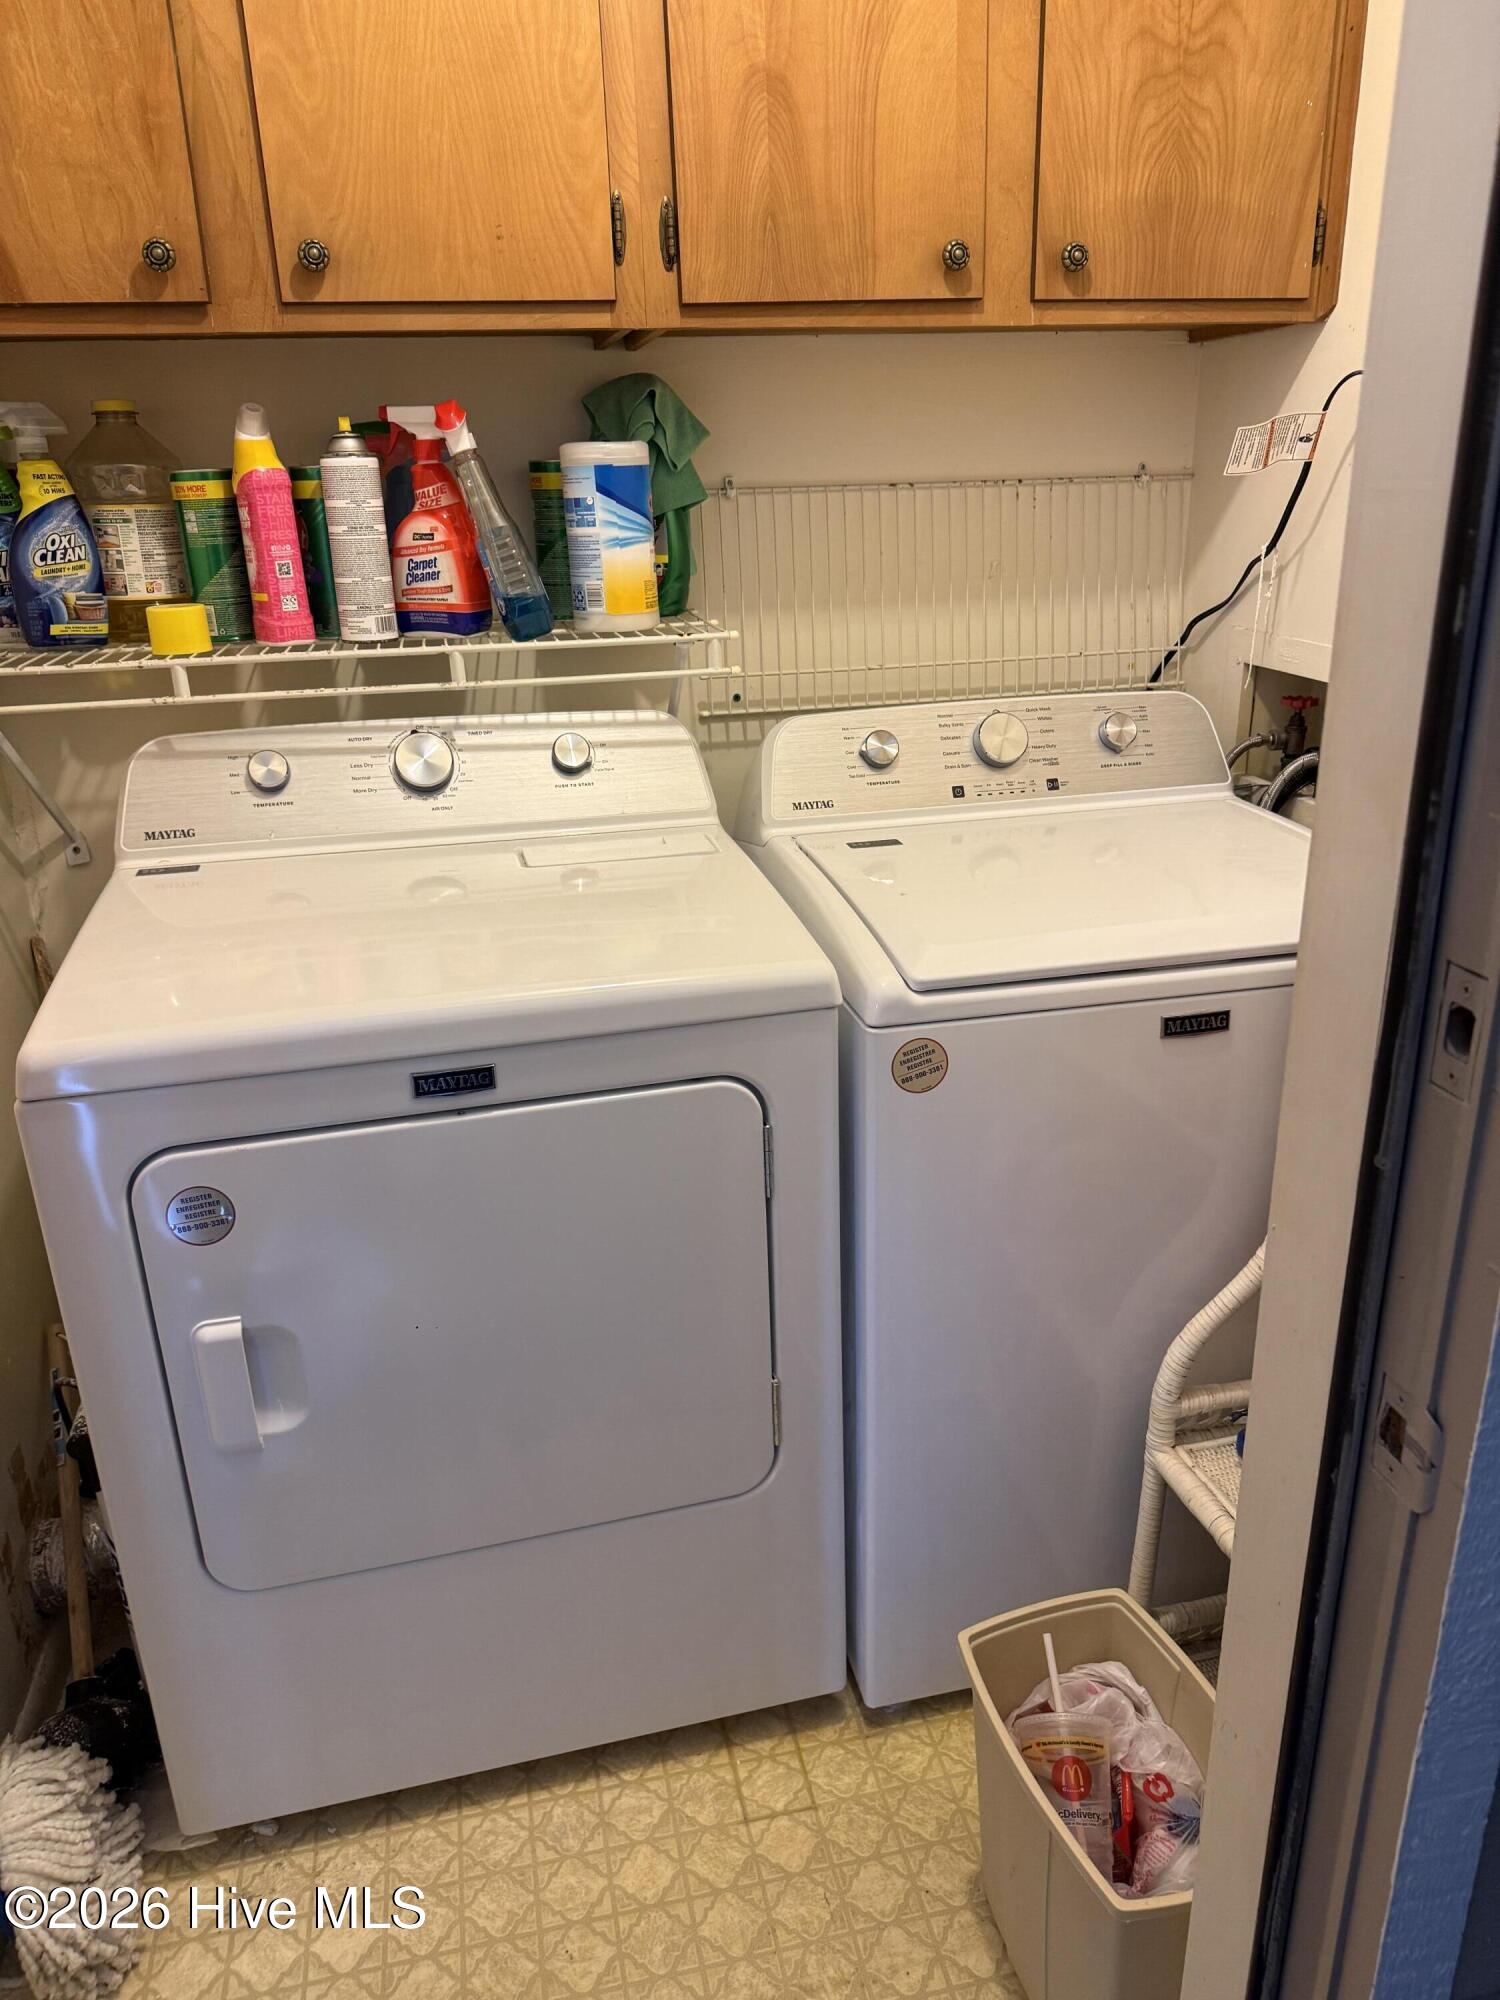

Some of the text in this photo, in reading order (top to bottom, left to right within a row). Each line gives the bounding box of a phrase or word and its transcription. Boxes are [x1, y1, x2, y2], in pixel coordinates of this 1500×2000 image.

[187, 484, 207, 493] MORE
[416, 484, 448, 501] VALUE
[419, 496, 442, 509] SIZE
[45, 532, 76, 551] OXI
[33, 544, 87, 567] CLEAN
[41, 567, 66, 575] LAUNDRY
[408, 557, 437, 571] Carpet
[406, 570, 440, 586] Cleaner
[792, 800, 834, 811] MAYTAG
[143, 828, 196, 841] MAYTAG
[1167, 1014, 1227, 1034] MAYTAG
[899, 1048, 936, 1066] ENREGISTRER
[902, 1044, 929, 1058] REGISTER
[906, 1057, 933, 1071] REGISTRE
[418, 1071, 490, 1093] MAYTAG
[180, 1193, 213, 1204] REGISTER
[176, 1199, 221, 1213] ENREGISTRER
[184, 1208, 217, 1220] REGISTRE
